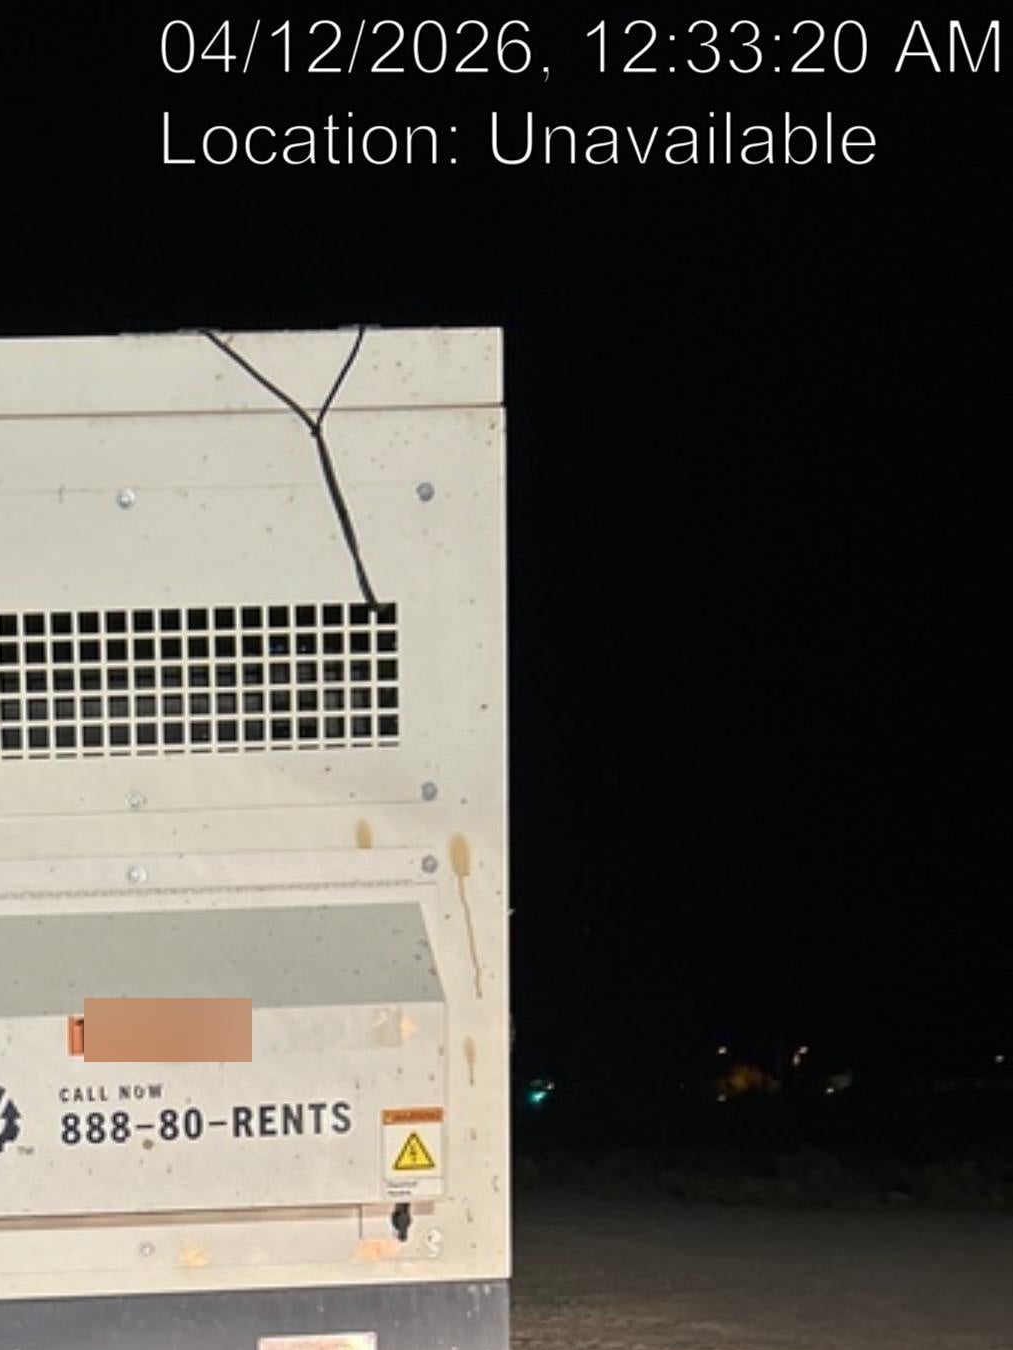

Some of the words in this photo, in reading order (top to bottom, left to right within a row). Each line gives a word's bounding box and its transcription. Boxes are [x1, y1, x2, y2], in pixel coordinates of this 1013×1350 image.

[58, 1086, 109, 1103] CALL
[118, 1083, 163, 1100] NOW
[60, 1102, 352, 1145] 888-80-RENTS
